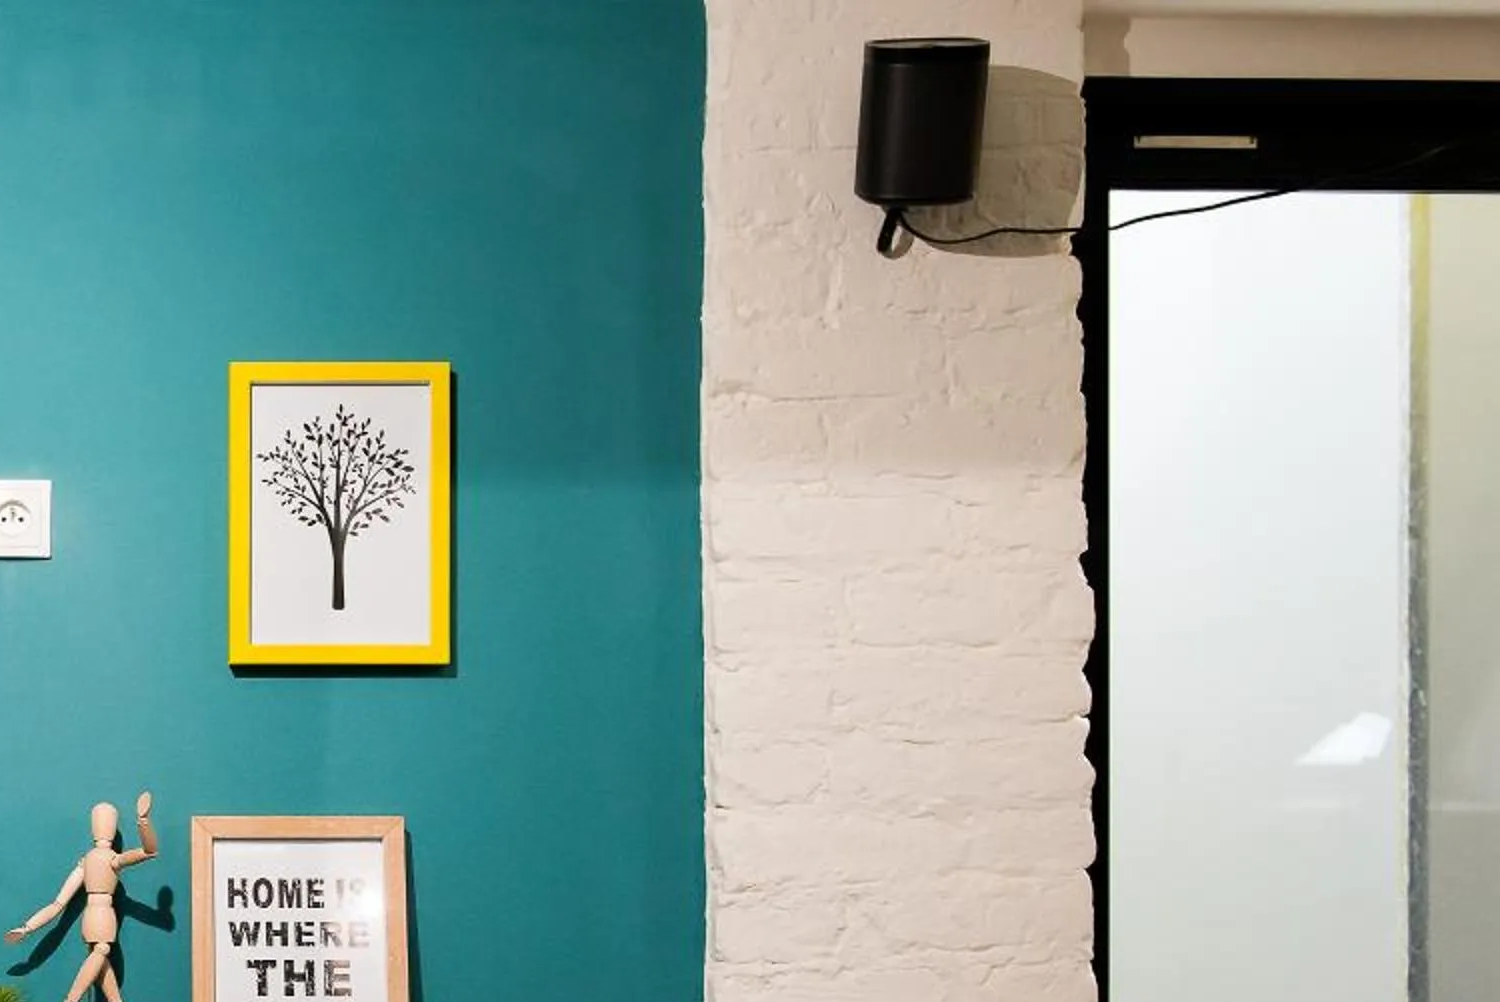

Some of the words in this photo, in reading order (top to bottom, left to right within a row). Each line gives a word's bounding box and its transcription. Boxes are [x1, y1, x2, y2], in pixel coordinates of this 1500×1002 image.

[227, 877, 325, 909] HOME
[228, 921, 369, 948] WHERE
[246, 959, 352, 998] THE
